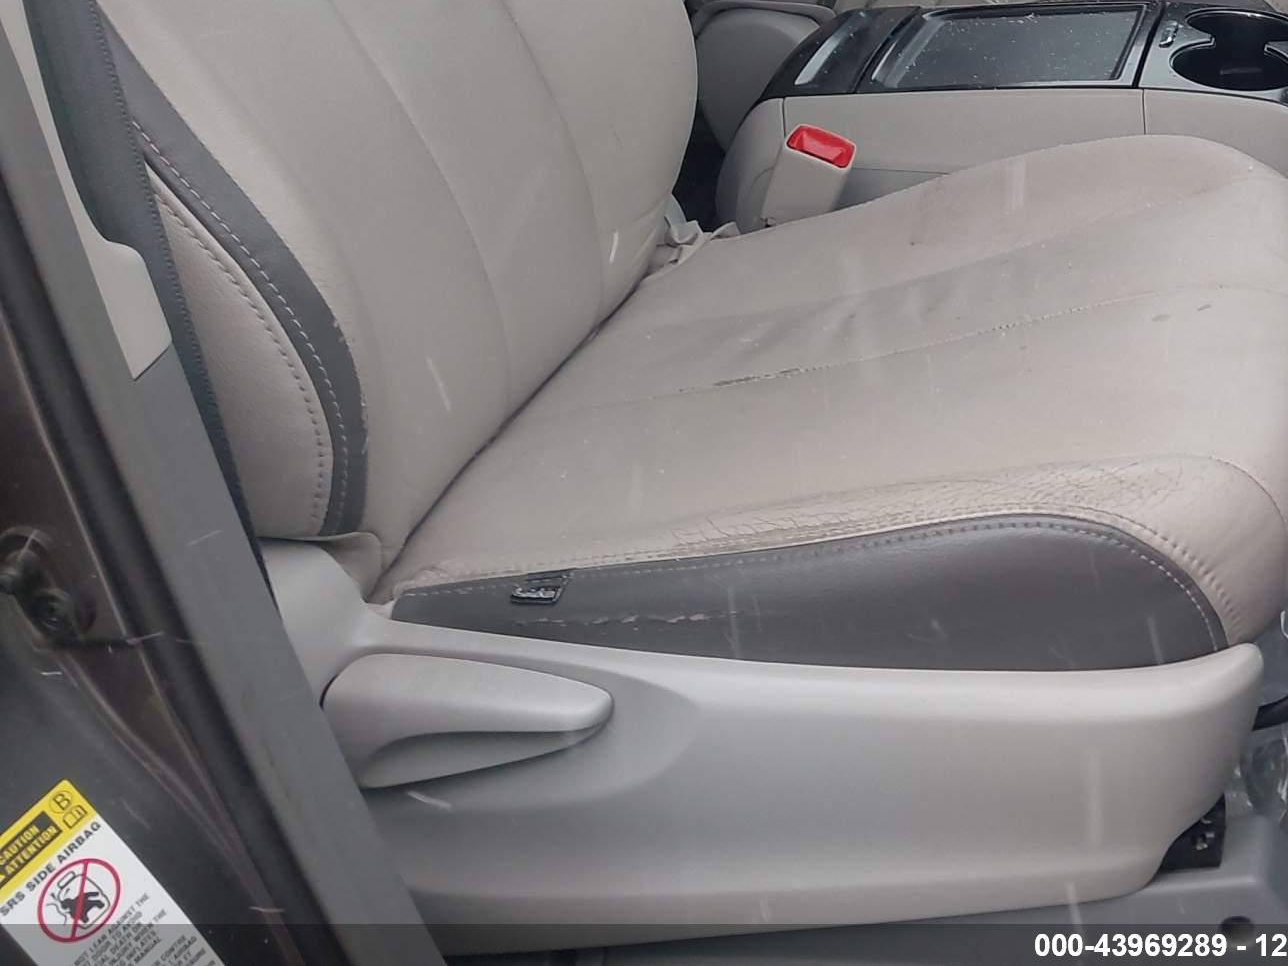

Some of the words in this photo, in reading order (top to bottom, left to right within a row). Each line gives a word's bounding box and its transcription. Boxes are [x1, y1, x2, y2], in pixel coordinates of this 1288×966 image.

[53, 791, 71, 810] B
[0, 888, 26, 917] SRS
[25, 862, 55, 892] SIDE
[56, 820, 101, 864] AIRBAG
[3, 824, 58, 876] ATTENTION
[106, 906, 136, 935] AGAINST
[135, 893, 149, 907] THE
